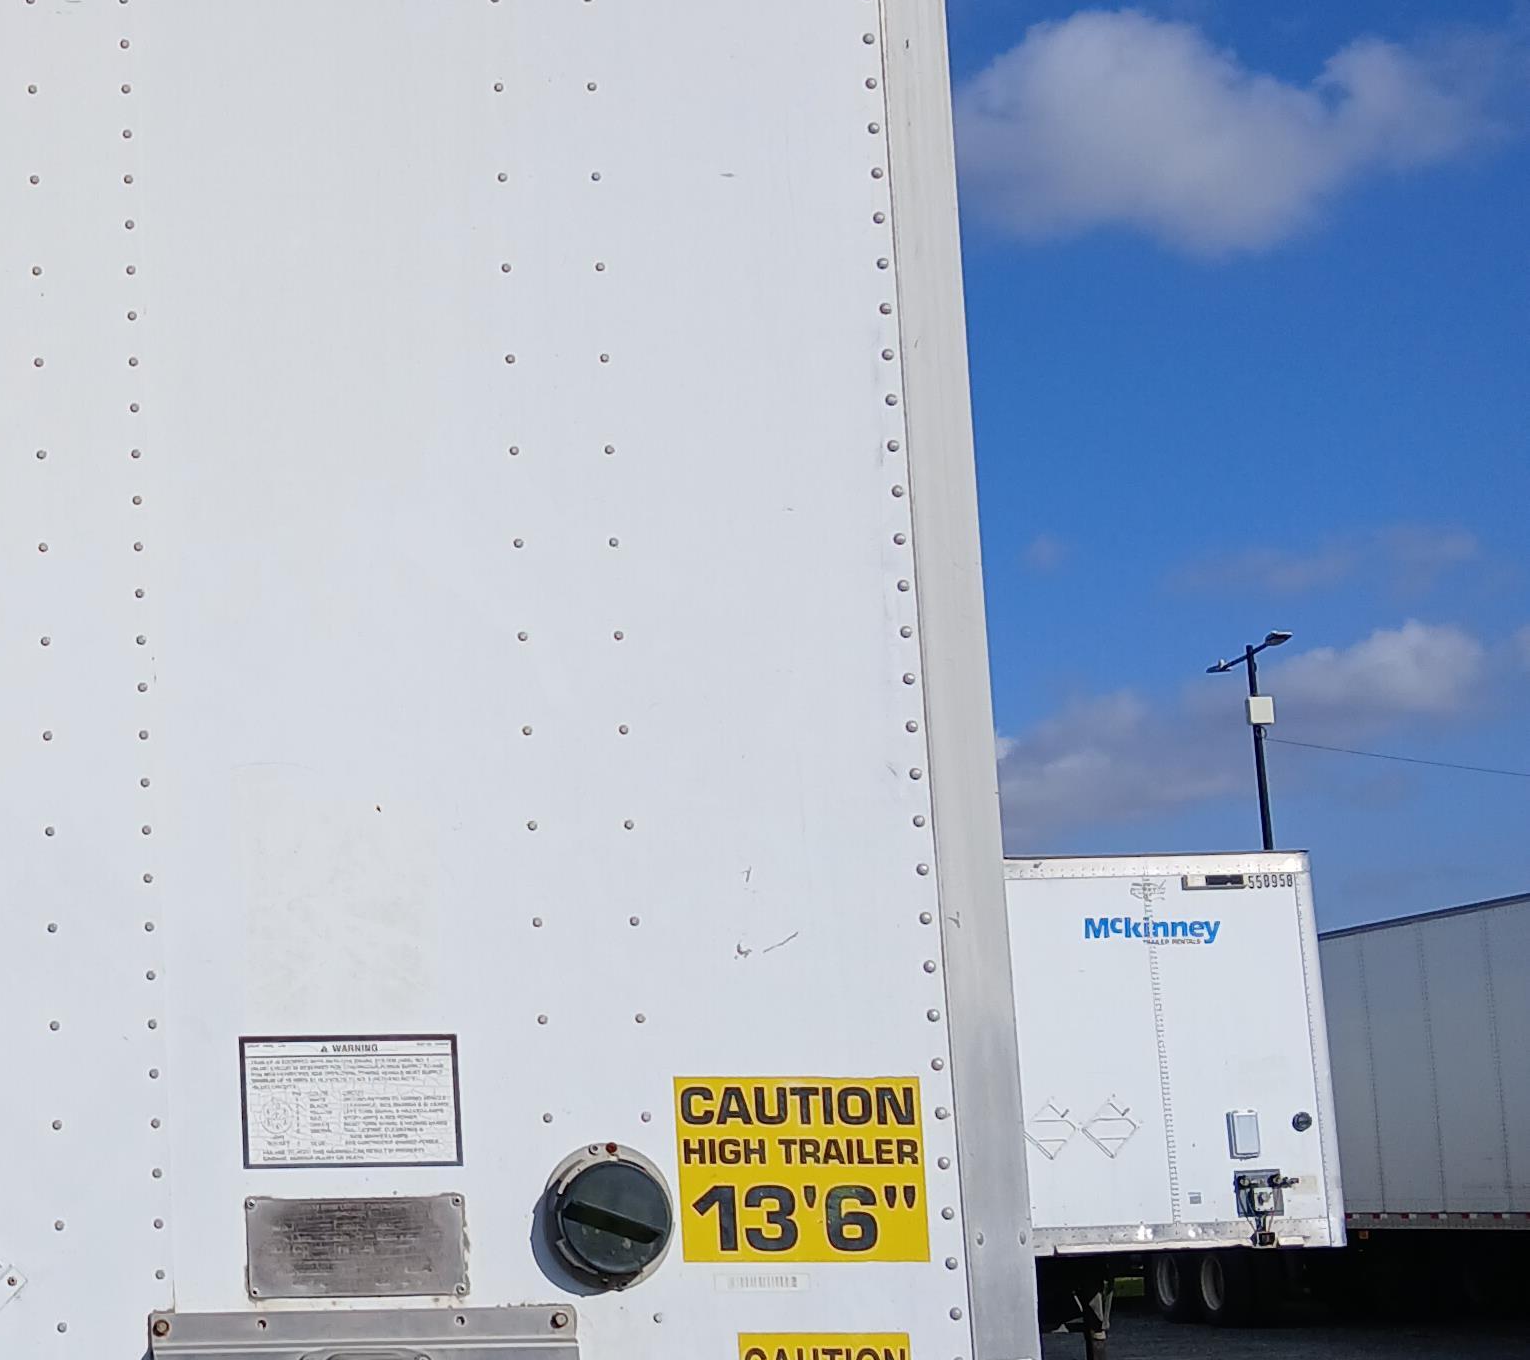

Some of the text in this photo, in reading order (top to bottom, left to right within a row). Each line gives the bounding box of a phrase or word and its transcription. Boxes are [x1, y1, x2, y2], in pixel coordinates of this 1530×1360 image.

[1248, 874, 1293, 889] 558958
[332, 1043, 378, 1052] WARNING
[680, 1086, 916, 1126] CAUTION
[683, 1138, 919, 1165] HIGH TRAILER
[692, 1184, 917, 1252] 13'6"
